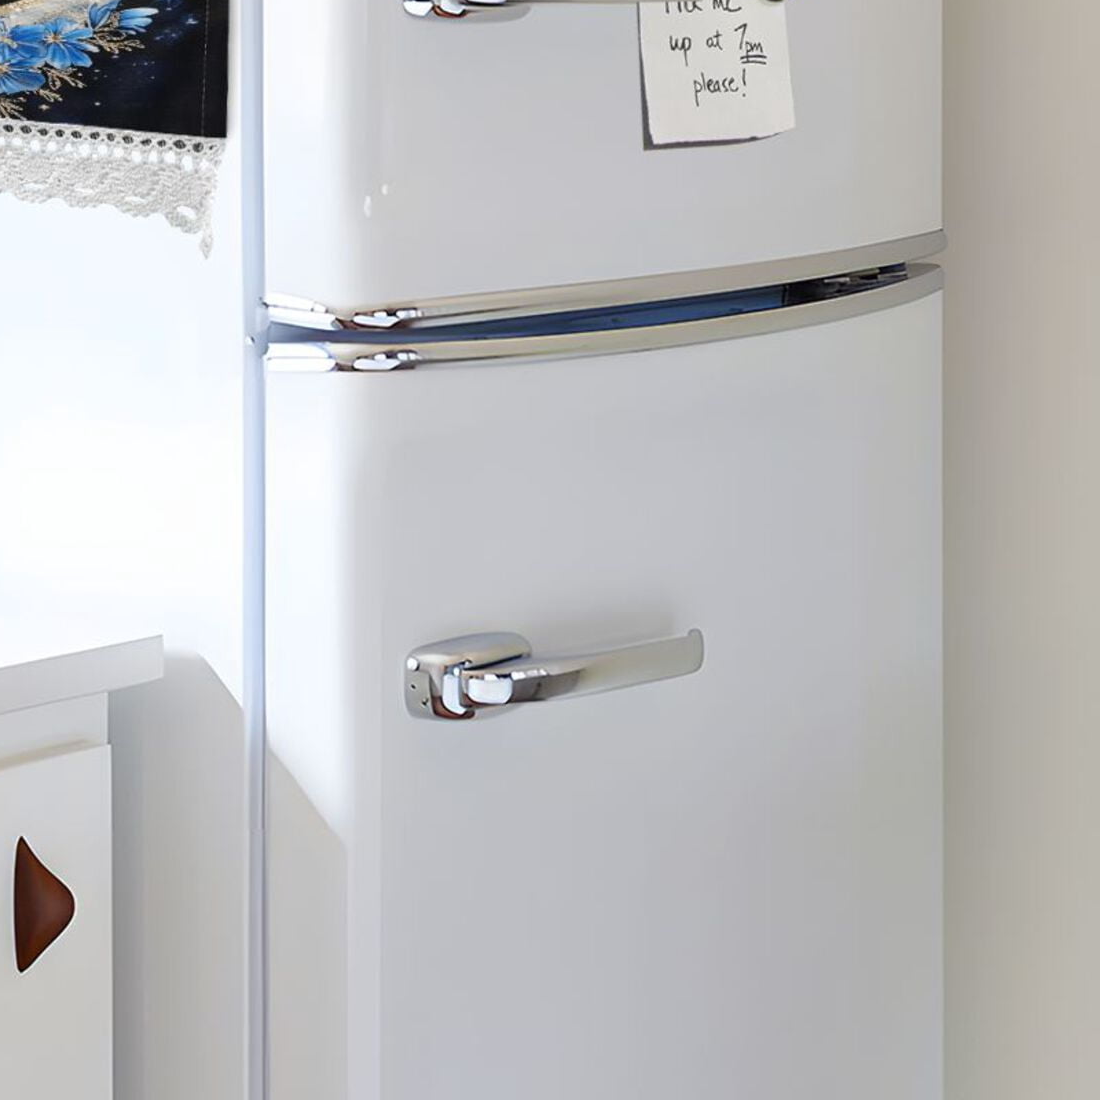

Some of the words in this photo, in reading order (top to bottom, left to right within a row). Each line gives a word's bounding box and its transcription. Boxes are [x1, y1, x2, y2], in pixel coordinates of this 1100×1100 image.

[669, 34, 692, 67] up
[706, 29, 723, 51] at
[693, 68, 747, 108] please!
